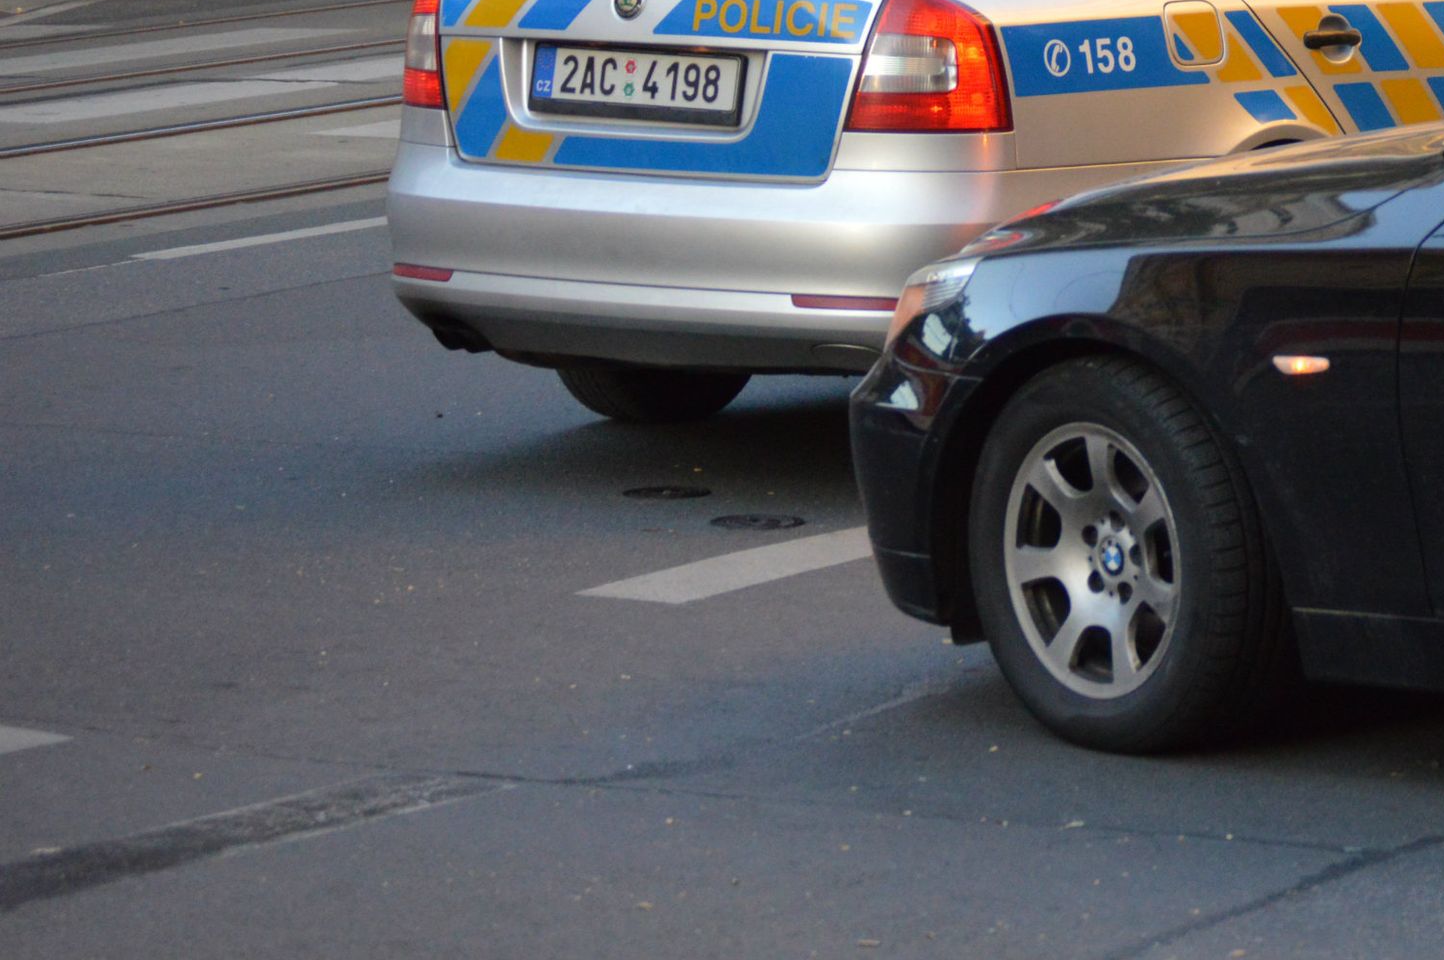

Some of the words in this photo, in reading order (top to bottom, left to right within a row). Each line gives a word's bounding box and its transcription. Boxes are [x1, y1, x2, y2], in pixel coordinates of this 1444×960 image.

[1078, 36, 1137, 75] 158
[535, 79, 551, 92] CZ
[560, 54, 618, 96] 2AC
[642, 59, 721, 104] 4198
